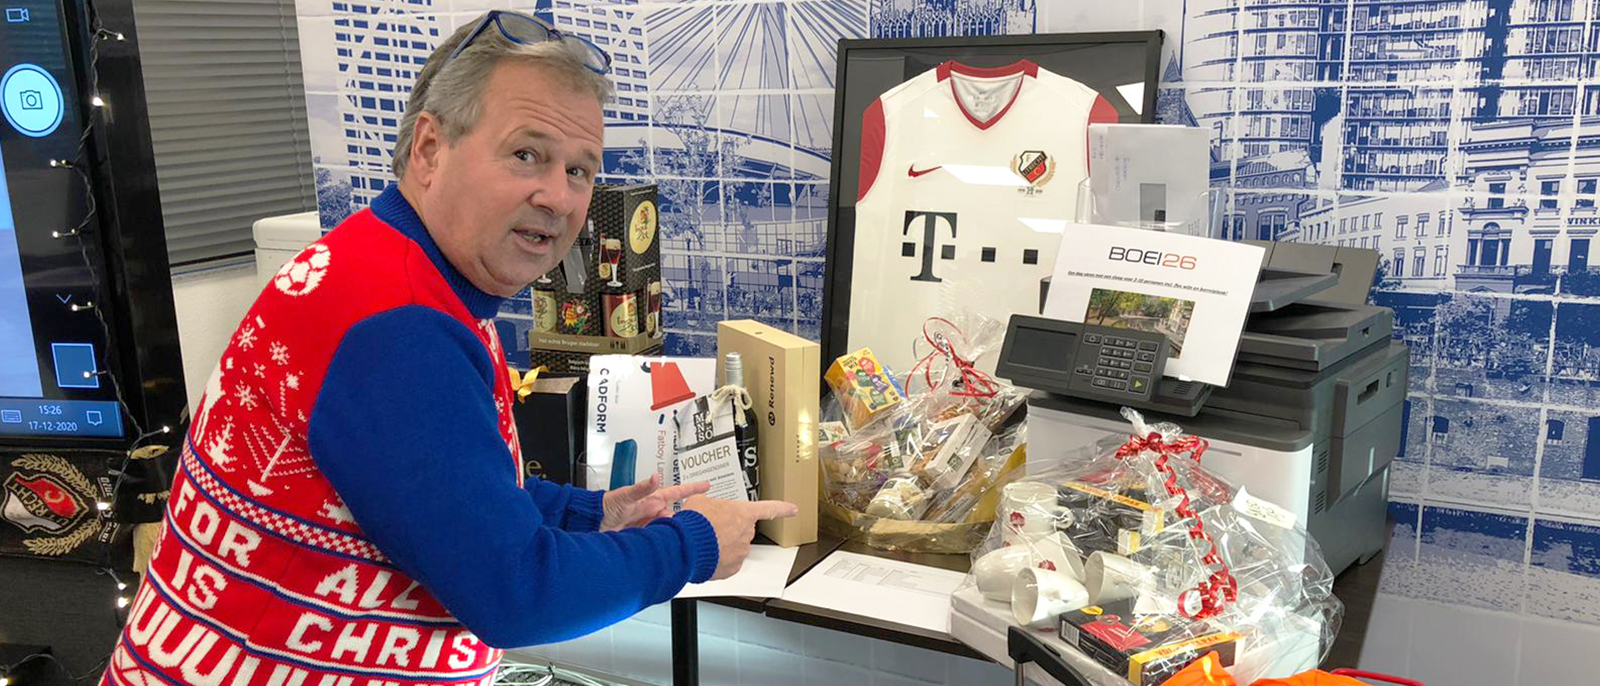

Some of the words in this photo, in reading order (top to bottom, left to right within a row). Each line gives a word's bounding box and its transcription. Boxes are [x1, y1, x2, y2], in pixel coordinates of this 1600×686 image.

[903, 210, 957, 282] T
[1108, 246, 1197, 270] BOEI26
[39, 405, 62, 415] 15:26
[596, 367, 610, 433] CADFORM
[28, 421, 78, 431] 17-12-2020
[656, 430, 667, 461] Fatboy
[681, 445, 731, 470] VOUCHER
[174, 478, 262, 568] FOR
[314, 563, 421, 610] ALL
[170, 549, 228, 610] IS
[285, 611, 498, 669] CHRIS
